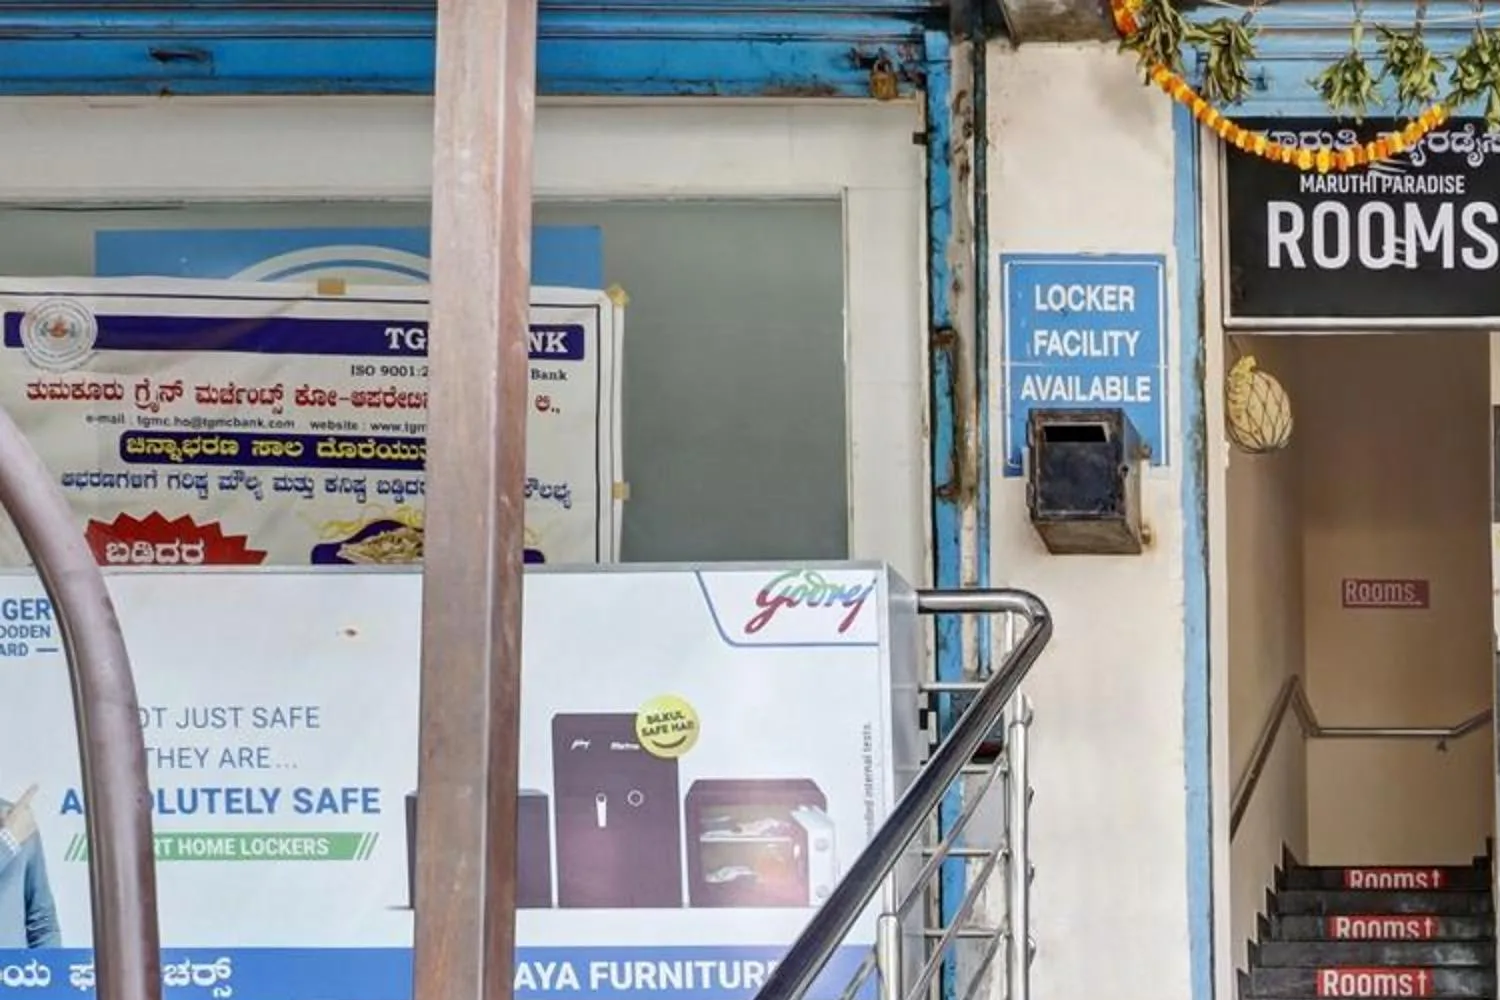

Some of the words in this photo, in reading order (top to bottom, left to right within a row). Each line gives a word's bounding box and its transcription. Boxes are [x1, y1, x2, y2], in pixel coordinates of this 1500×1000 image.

[1300, 174, 1379, 194] MARUTHI
[1382, 174, 1465, 194] PARADISE
[1267, 200, 1500, 270] ROOMS
[1035, 284, 1135, 312] LOCKER
[384, 327, 428, 350] TG
[528, 331, 568, 353] NK
[1033, 329, 1141, 357] FACILITY
[351, 364, 375, 377] ISO
[531, 368, 567, 381] Bank
[1021, 375, 1151, 402] AVAILABLE
[310, 420, 358, 432] website
[744, 568, 877, 634] Godrej
[1345, 580, 1416, 602] Rooms
[2, 598, 51, 621] GER
[0, 624, 51, 639] OODEN
[140, 707, 165, 728] OT
[176, 707, 243, 728] JUST
[252, 706, 320, 728] SAFE
[292, 787, 381, 814] SAFE
[178, 838, 234, 855] HOME
[240, 838, 329, 856] LOCKERS
[1336, 916, 1420, 938] Rooms
[513, 961, 581, 990] AYA
[589, 960, 780, 990] FURNITUR
[1323, 969, 1414, 997] Rooms
